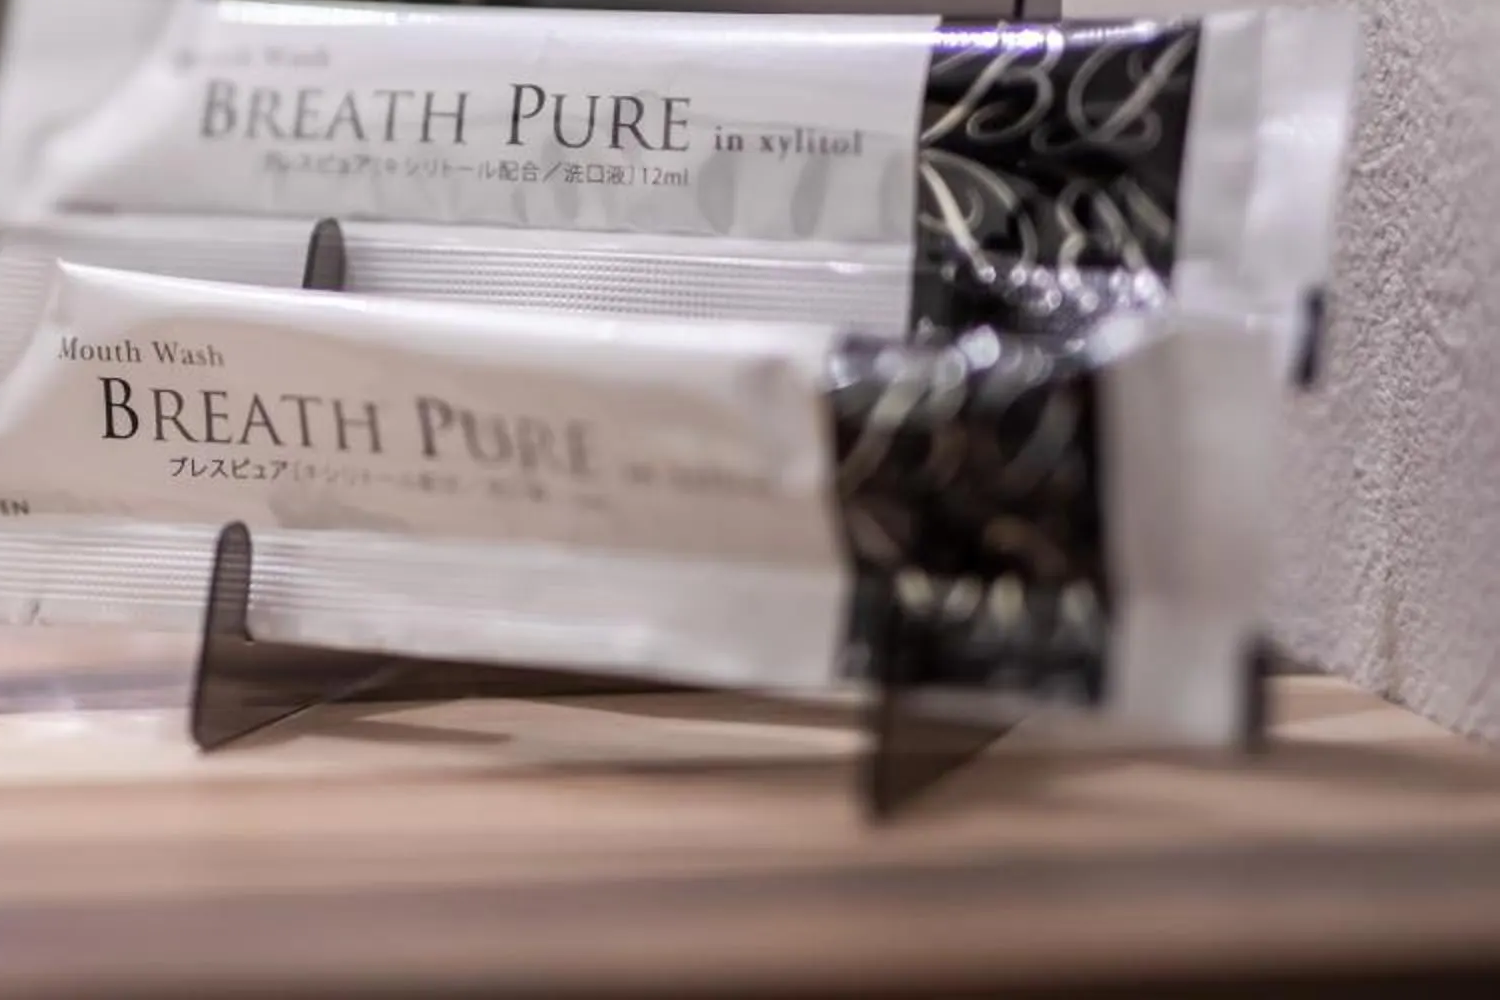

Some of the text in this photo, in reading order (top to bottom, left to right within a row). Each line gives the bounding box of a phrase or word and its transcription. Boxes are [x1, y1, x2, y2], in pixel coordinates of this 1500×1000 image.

[200, 77, 864, 164] BREATH PURE in xylitol
[58, 337, 226, 368] Mouth Wash
[98, 376, 384, 454] BREATH
